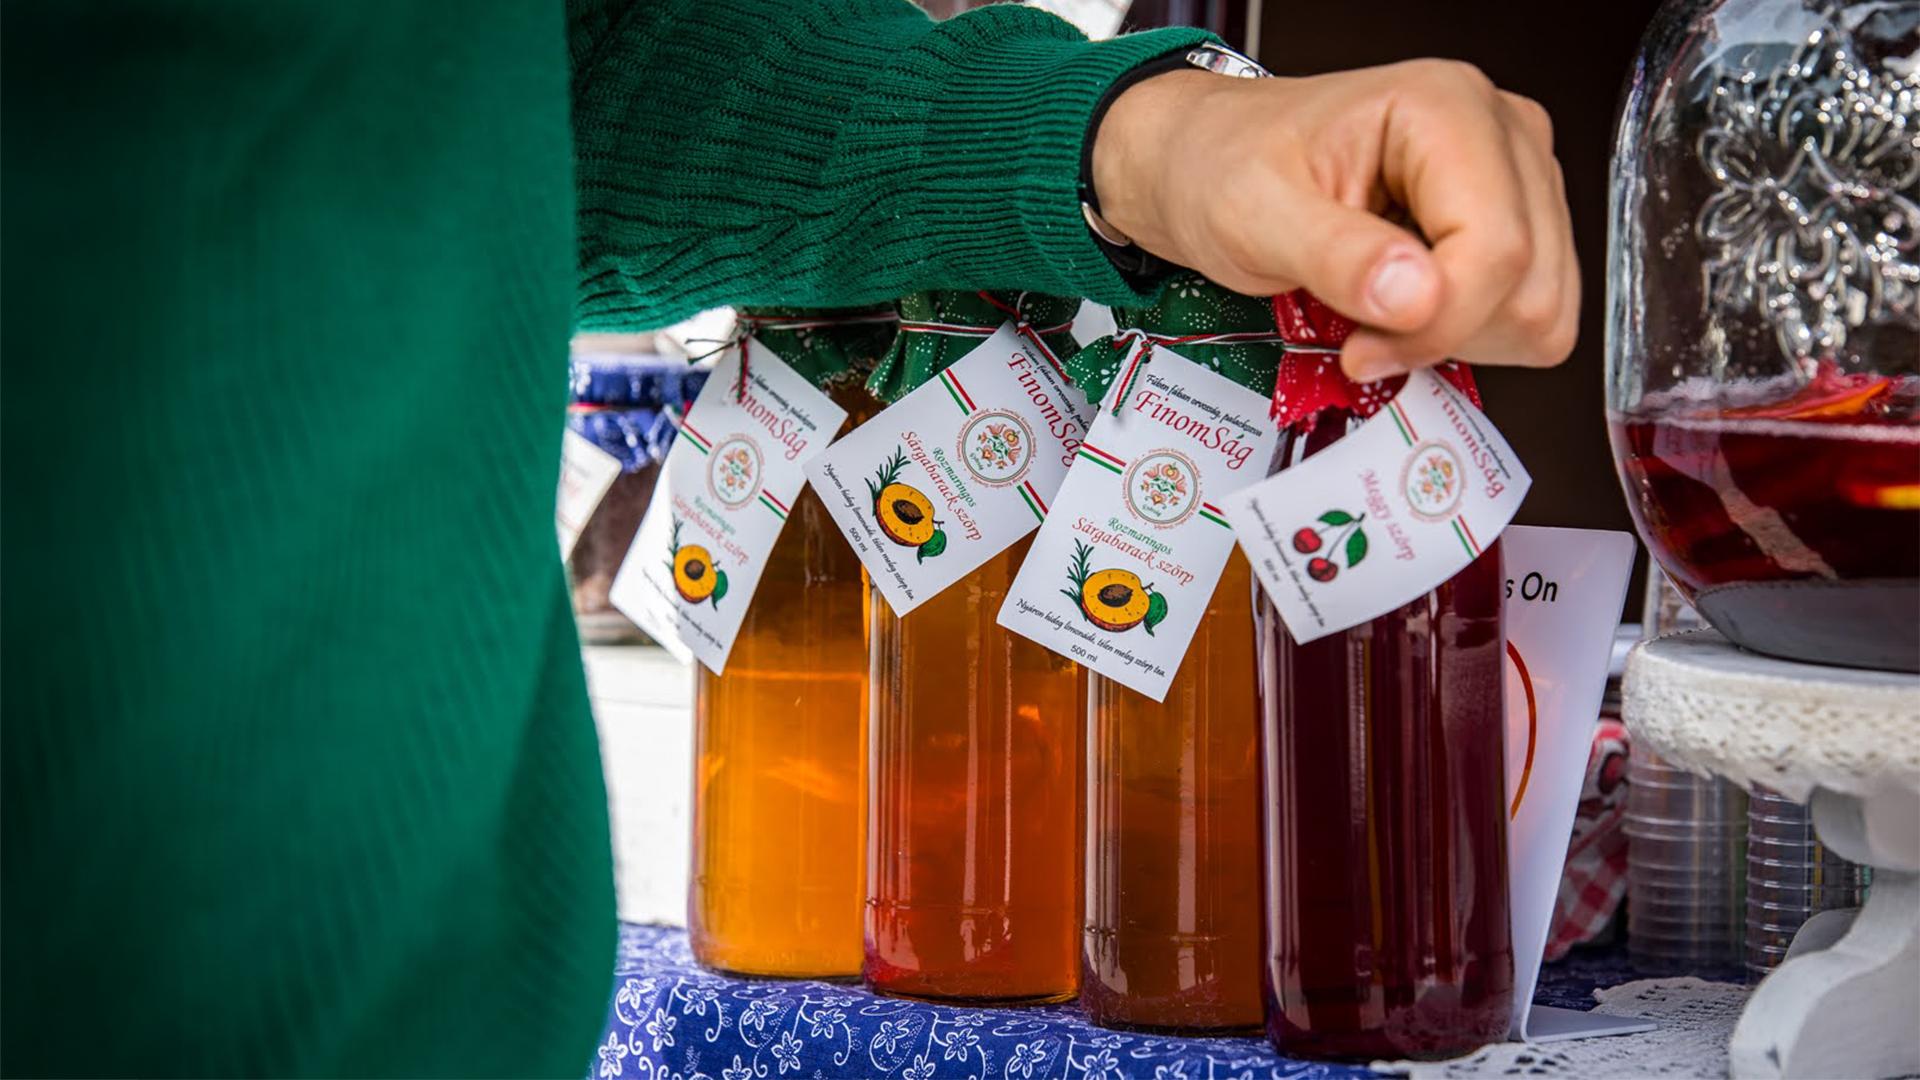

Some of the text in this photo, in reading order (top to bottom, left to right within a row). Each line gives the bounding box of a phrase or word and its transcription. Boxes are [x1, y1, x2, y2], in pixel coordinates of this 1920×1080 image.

[1167, 384, 1192, 402] fában
[1133, 390, 1255, 470] FinomSág
[901, 431, 960, 512] Sárgabarack
[932, 446, 977, 508] Rozmaringos
[849, 527, 869, 553] 500 ml
[1071, 516, 1195, 587] Sárgabarack szörp
[1107, 517, 1174, 555] Rozmaringos
[1521, 571, 1558, 602] On
[1016, 598, 1045, 619] Nyáron
[1044, 611, 1064, 631] hideg
[1113, 646, 1135, 666] meleg
[1070, 644, 1099, 664] 500 ml
